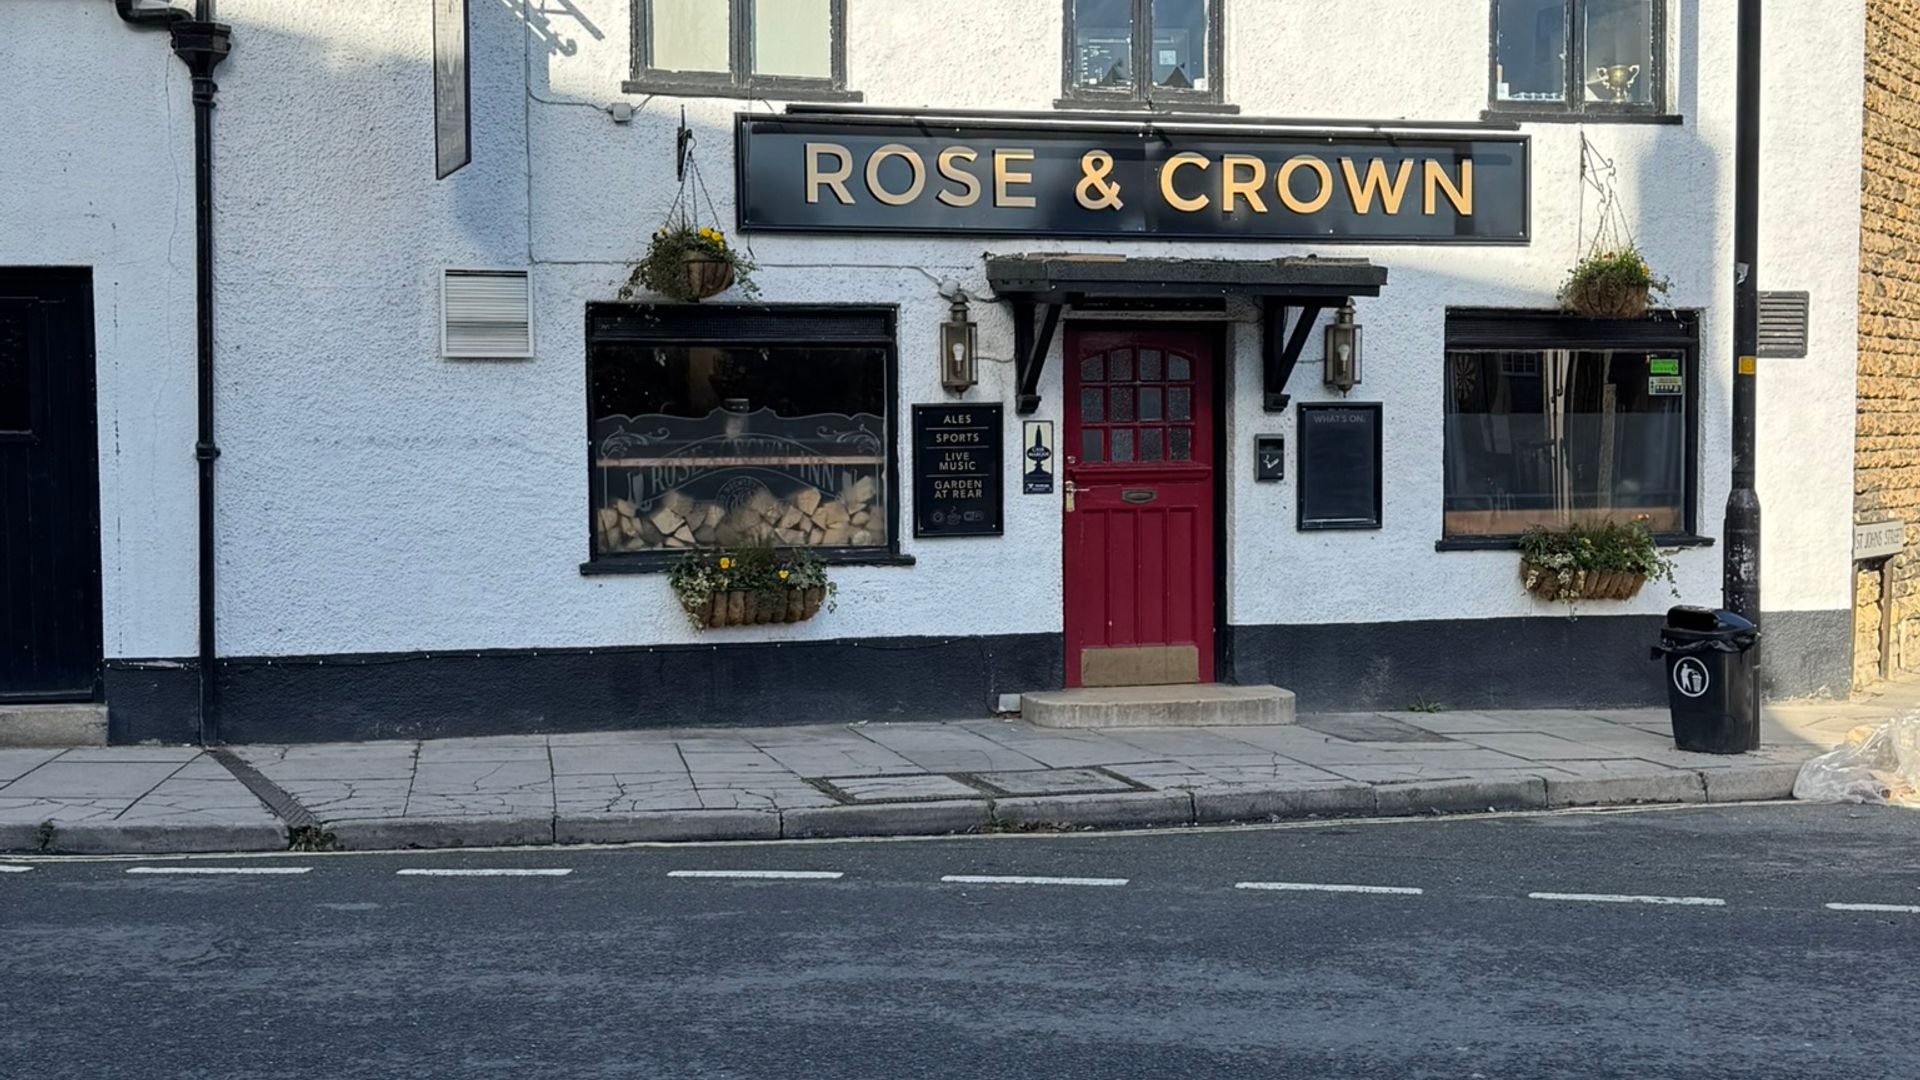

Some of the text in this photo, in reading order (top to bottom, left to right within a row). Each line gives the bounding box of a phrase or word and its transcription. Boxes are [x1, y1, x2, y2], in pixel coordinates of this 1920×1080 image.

[805, 142, 1473, 216] ROSE & CROWN
[943, 414, 972, 424] ALES
[936, 433, 980, 443] SPORTS
[945, 452, 970, 461] LIVE
[939, 461, 977, 471] MUSIC
[934, 480, 982, 490] GARDEN
[934, 489, 982, 499] AT REAR
[1856, 533, 1863, 550] ST
[1864, 530, 1883, 549] JOHNS
